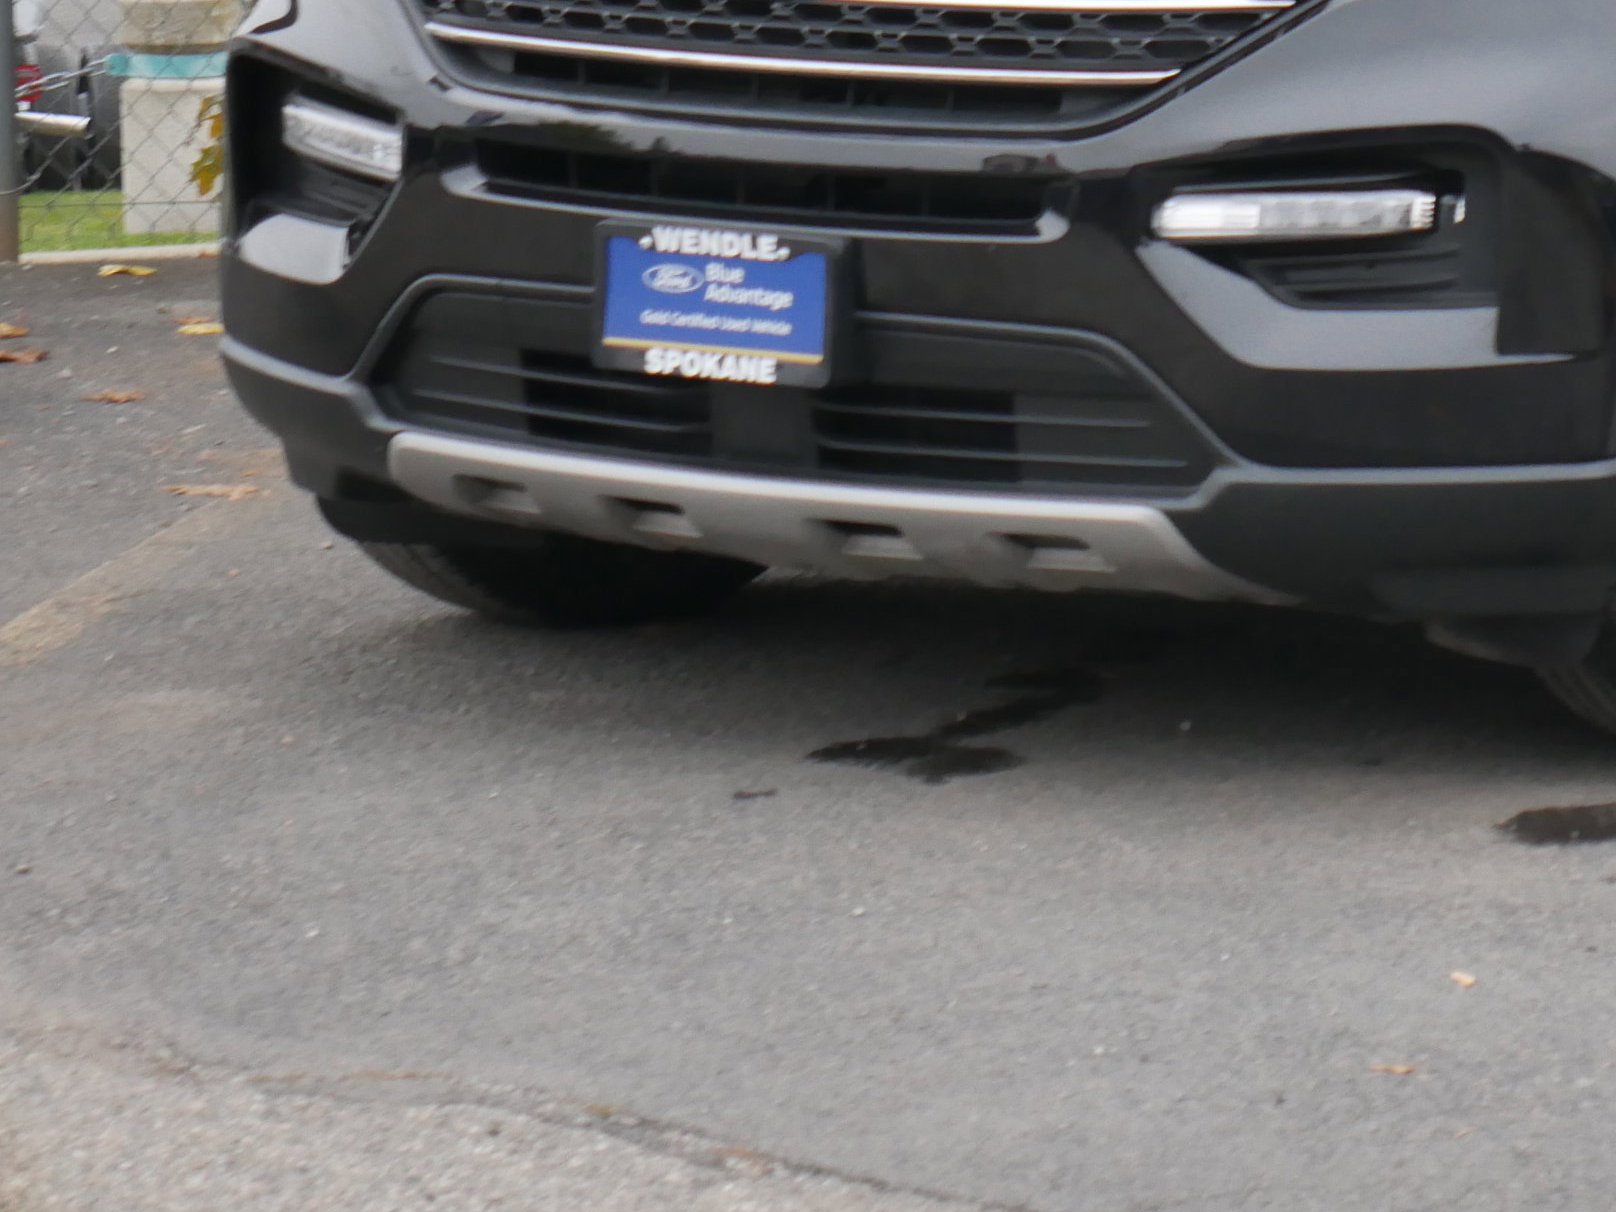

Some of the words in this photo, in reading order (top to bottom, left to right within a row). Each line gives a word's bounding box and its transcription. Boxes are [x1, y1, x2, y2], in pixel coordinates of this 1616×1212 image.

[652, 225, 779, 261] WENDLE
[705, 262, 745, 284] Blue
[704, 284, 794, 311] Advantage
[644, 347, 778, 384] SPOKANE
